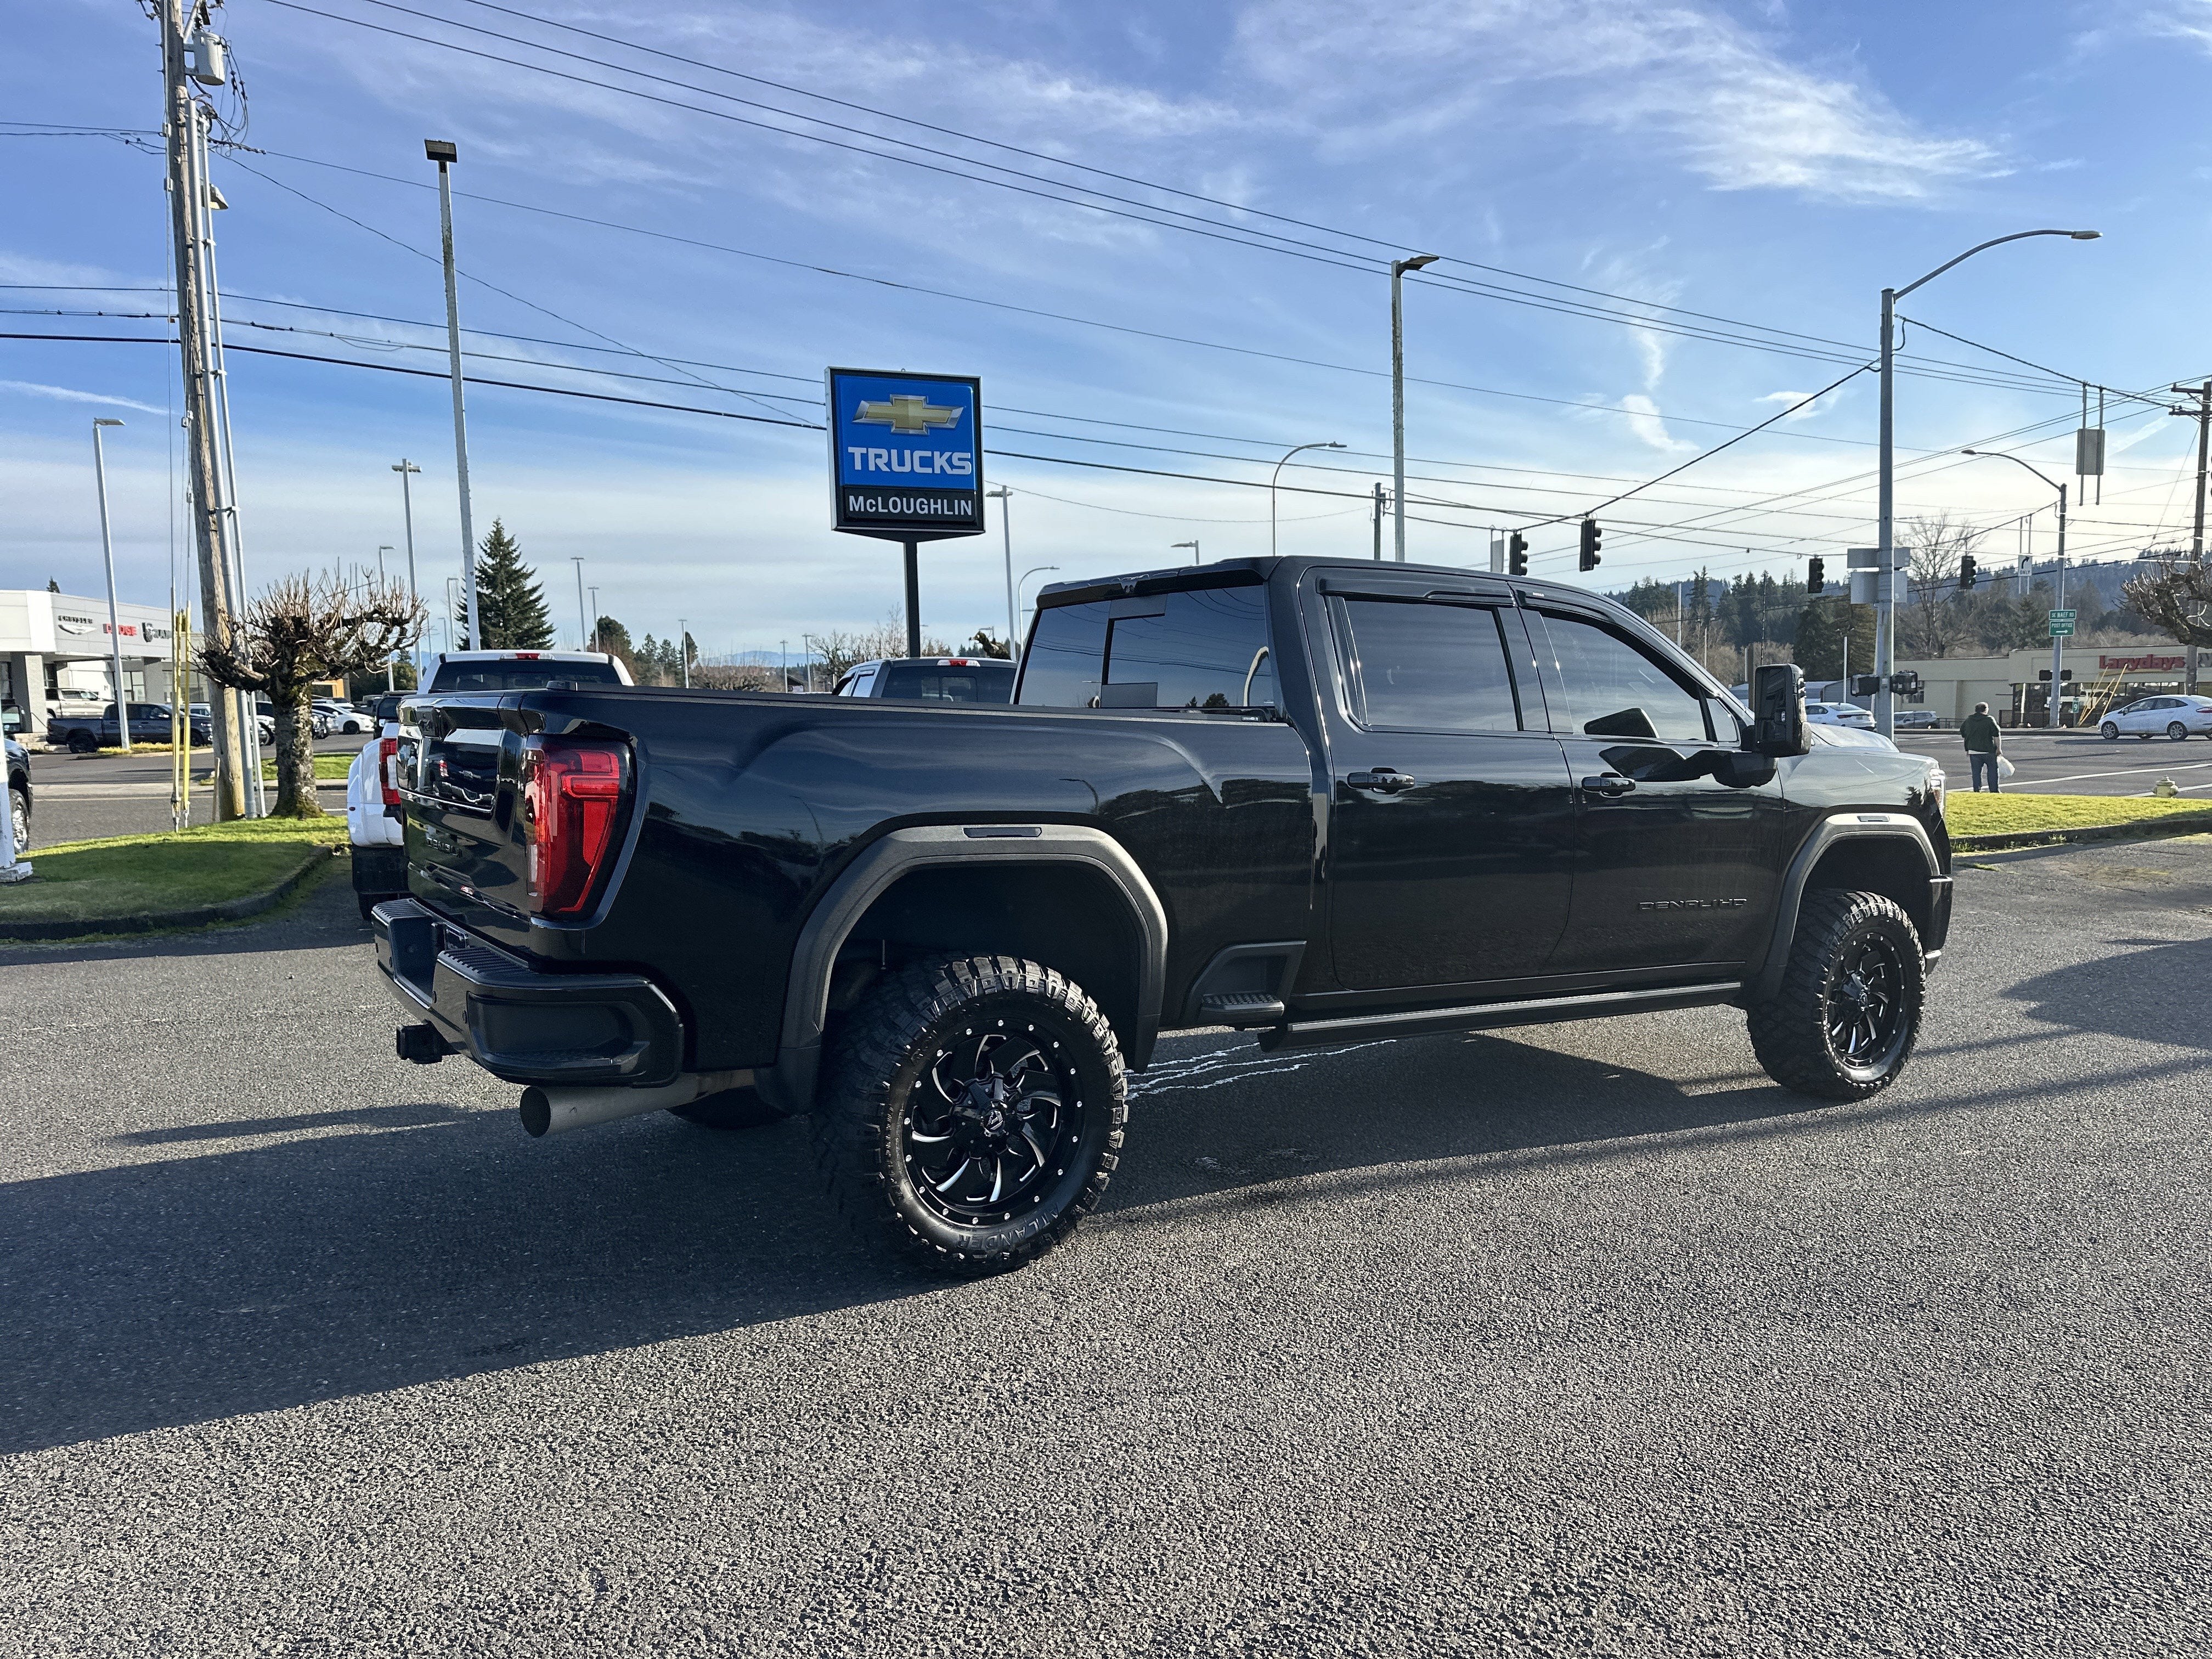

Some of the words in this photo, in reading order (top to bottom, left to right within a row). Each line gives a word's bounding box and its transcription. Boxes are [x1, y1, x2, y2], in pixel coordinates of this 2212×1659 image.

[848, 446, 972, 475] TRUCKS
[849, 495, 972, 516] McLOUGHLIN
[102, 623, 138, 636] DDGE
[2099, 654, 2186, 671] Lazydays
